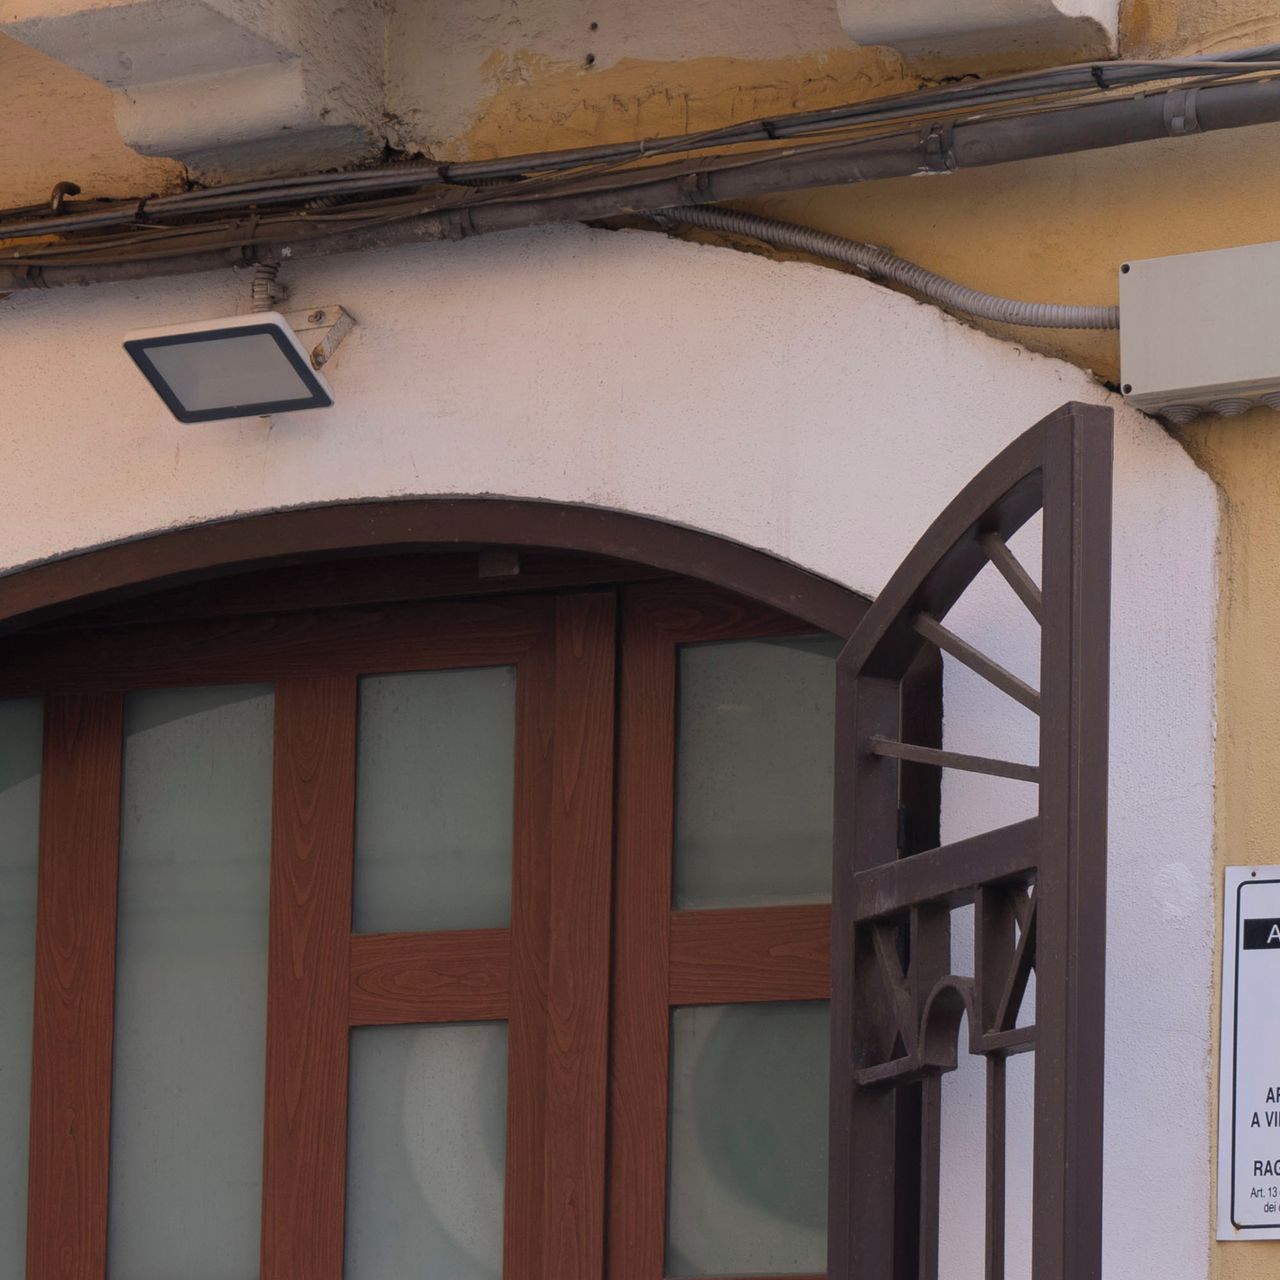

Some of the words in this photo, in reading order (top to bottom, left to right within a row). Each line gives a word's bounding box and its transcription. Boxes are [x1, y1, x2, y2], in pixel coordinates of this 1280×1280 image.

[1250, 1111, 1261, 1128] A
[1250, 1187, 1265, 1199] Art.
[1267, 1186, 1278, 1198] 13
[1263, 1202, 1277, 1213] dei
